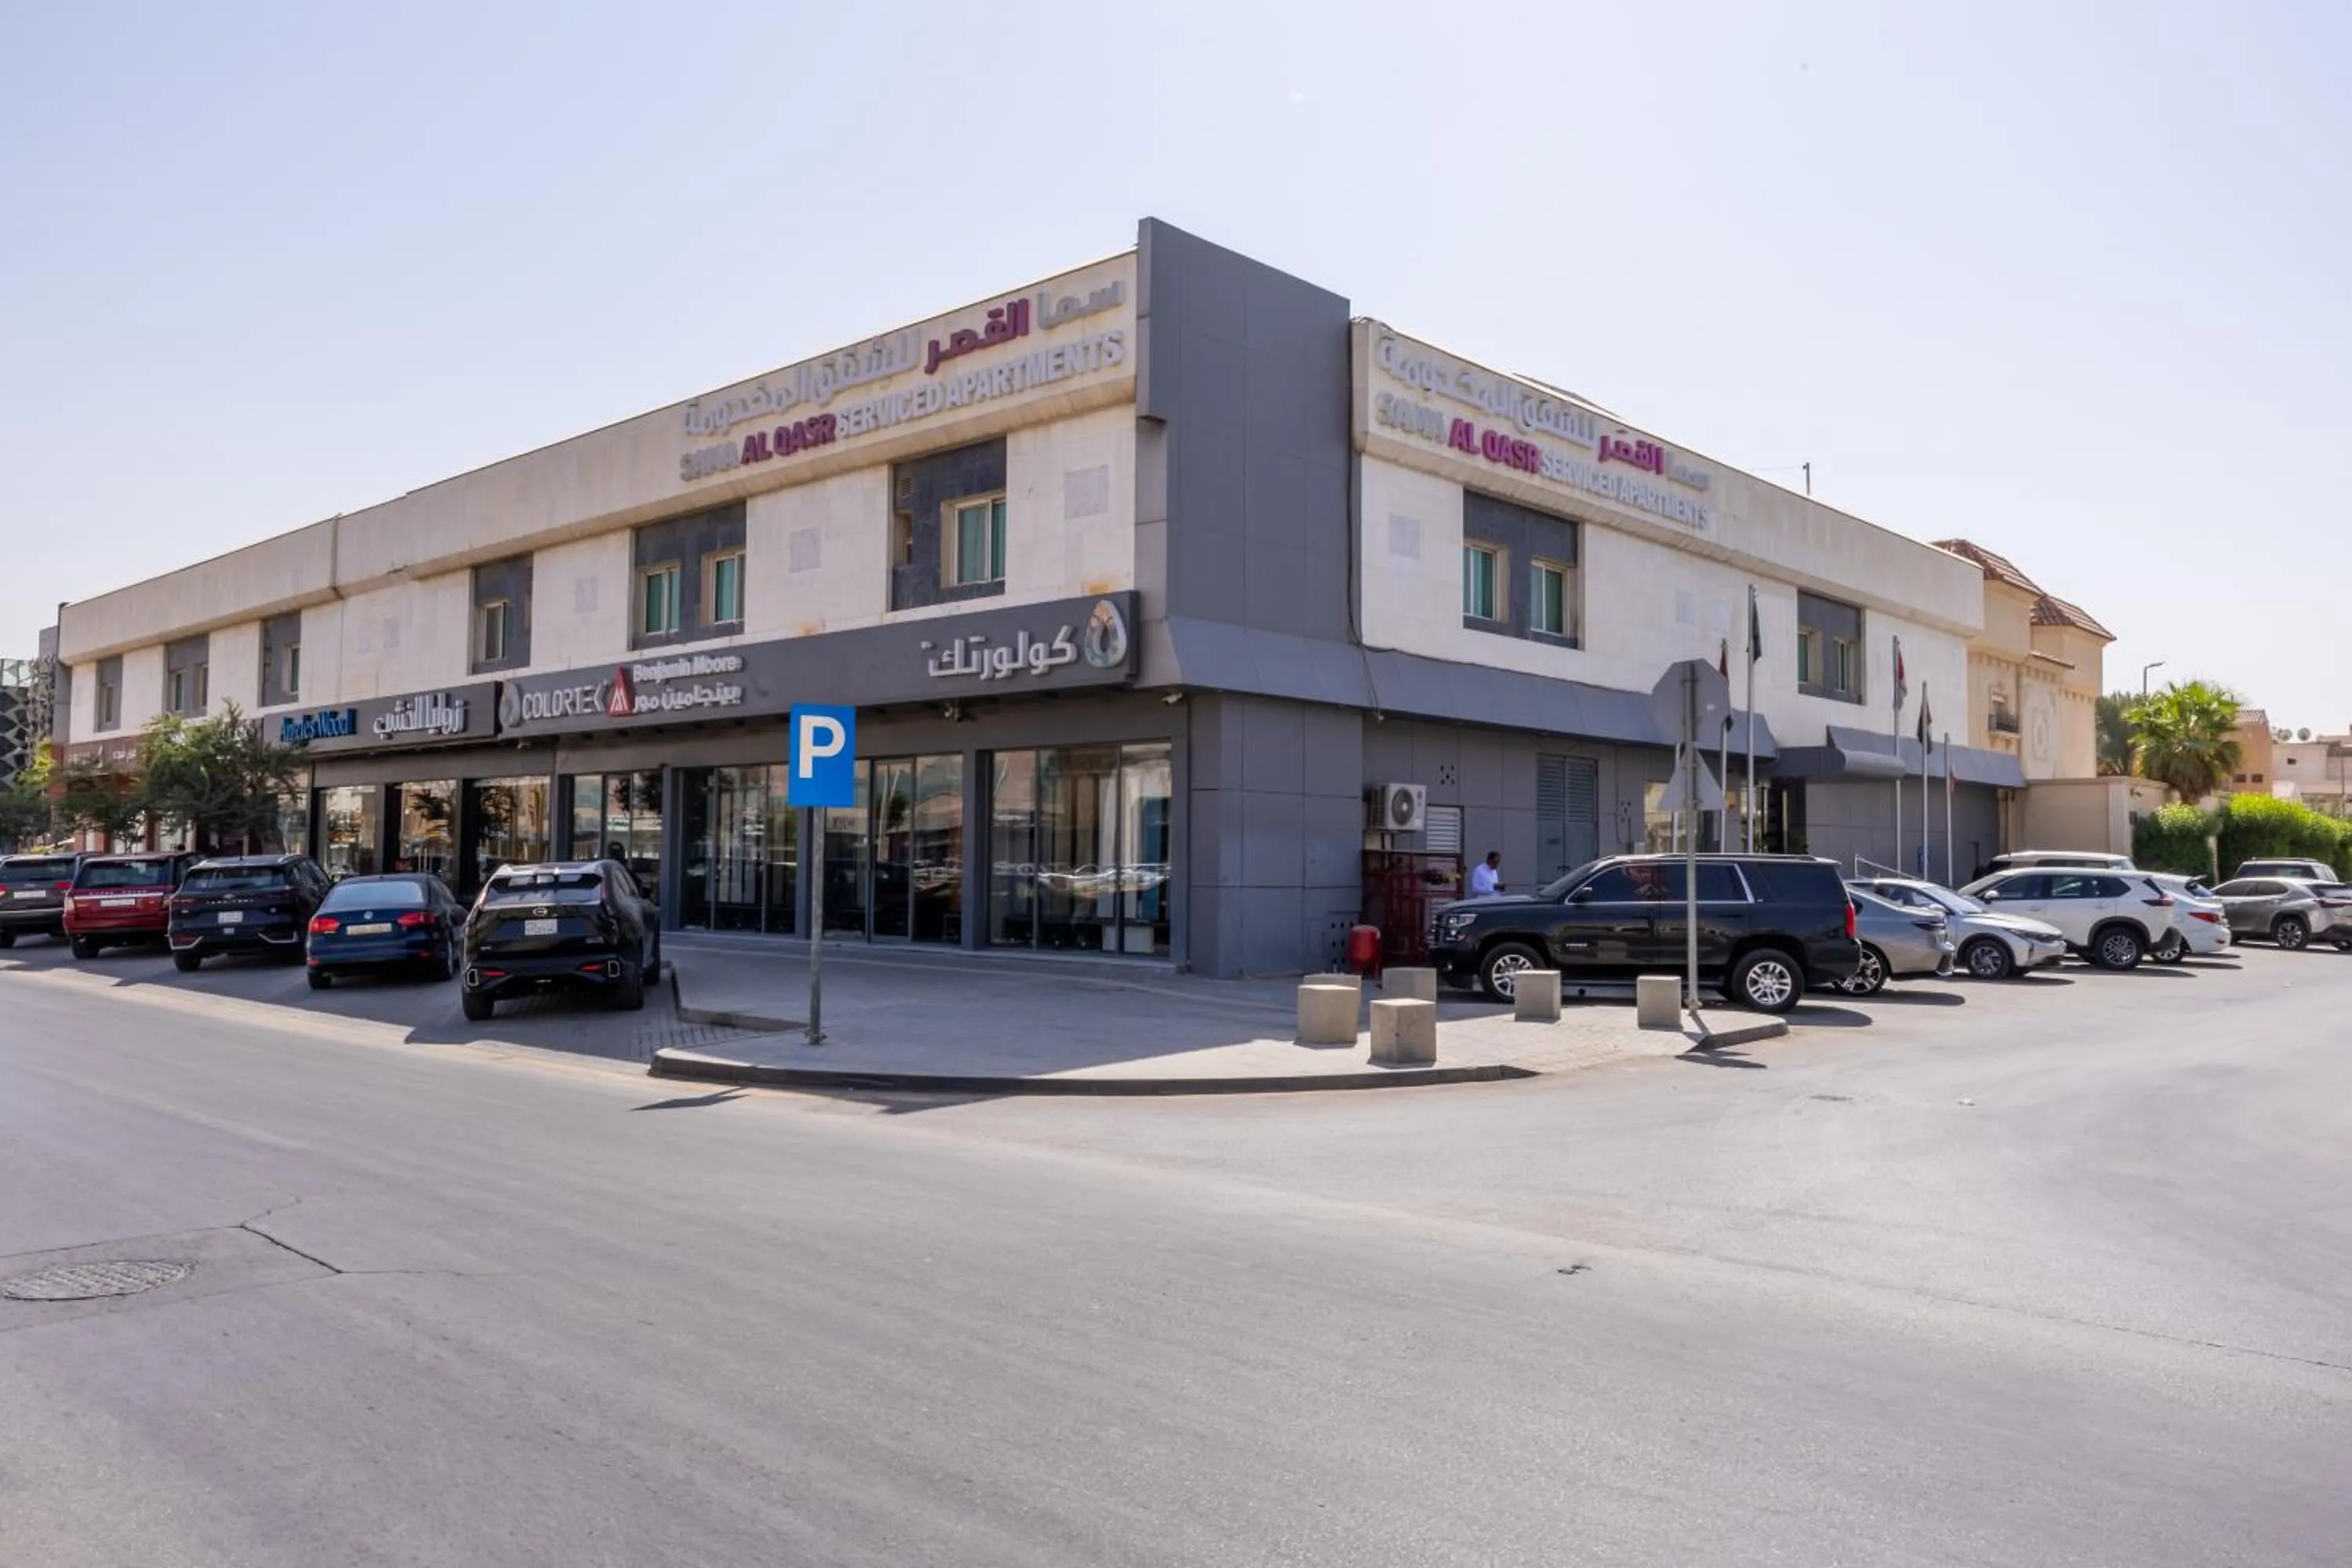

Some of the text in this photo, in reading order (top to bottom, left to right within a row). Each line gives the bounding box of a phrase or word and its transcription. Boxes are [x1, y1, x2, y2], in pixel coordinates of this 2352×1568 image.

[1037, 280, 1126, 330] سما
[924, 298, 1029, 375] القصر
[741, 431, 773, 465] AL
[773, 412, 837, 456] QASR
[837, 381, 943, 439] SERVICED
[945, 329, 1126, 412] APARTMENTS
[1449, 418, 1479, 454] AL
[1481, 429, 1542, 474] QASR
[1541, 451, 1621, 502] SERVICED
[1618, 478, 1709, 529] APARTMENTS
[1598, 435, 1664, 474] القصر
[633, 656, 739, 683] Benjamin Moore
[928, 625, 1077, 680] كولورتك
[633, 694, 659, 713] مور
[800, 714, 846, 779] P
